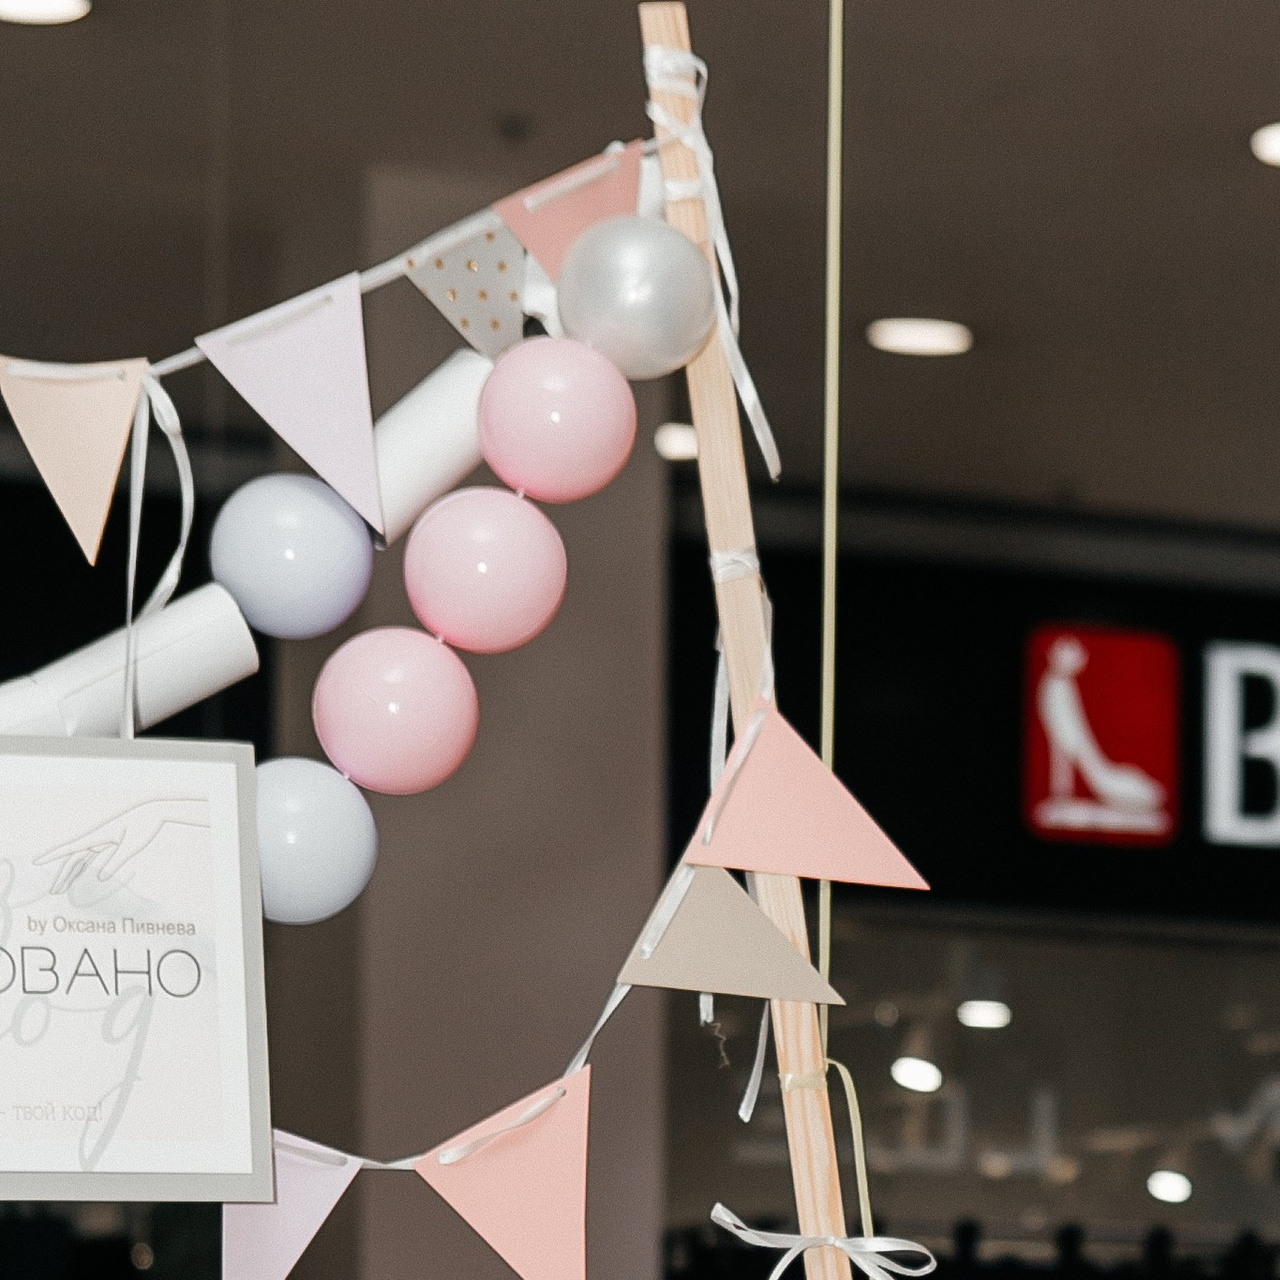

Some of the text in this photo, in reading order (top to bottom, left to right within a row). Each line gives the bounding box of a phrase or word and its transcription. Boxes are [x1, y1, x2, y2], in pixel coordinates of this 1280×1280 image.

[27, 915, 196, 936] by Оксана Пивнева
